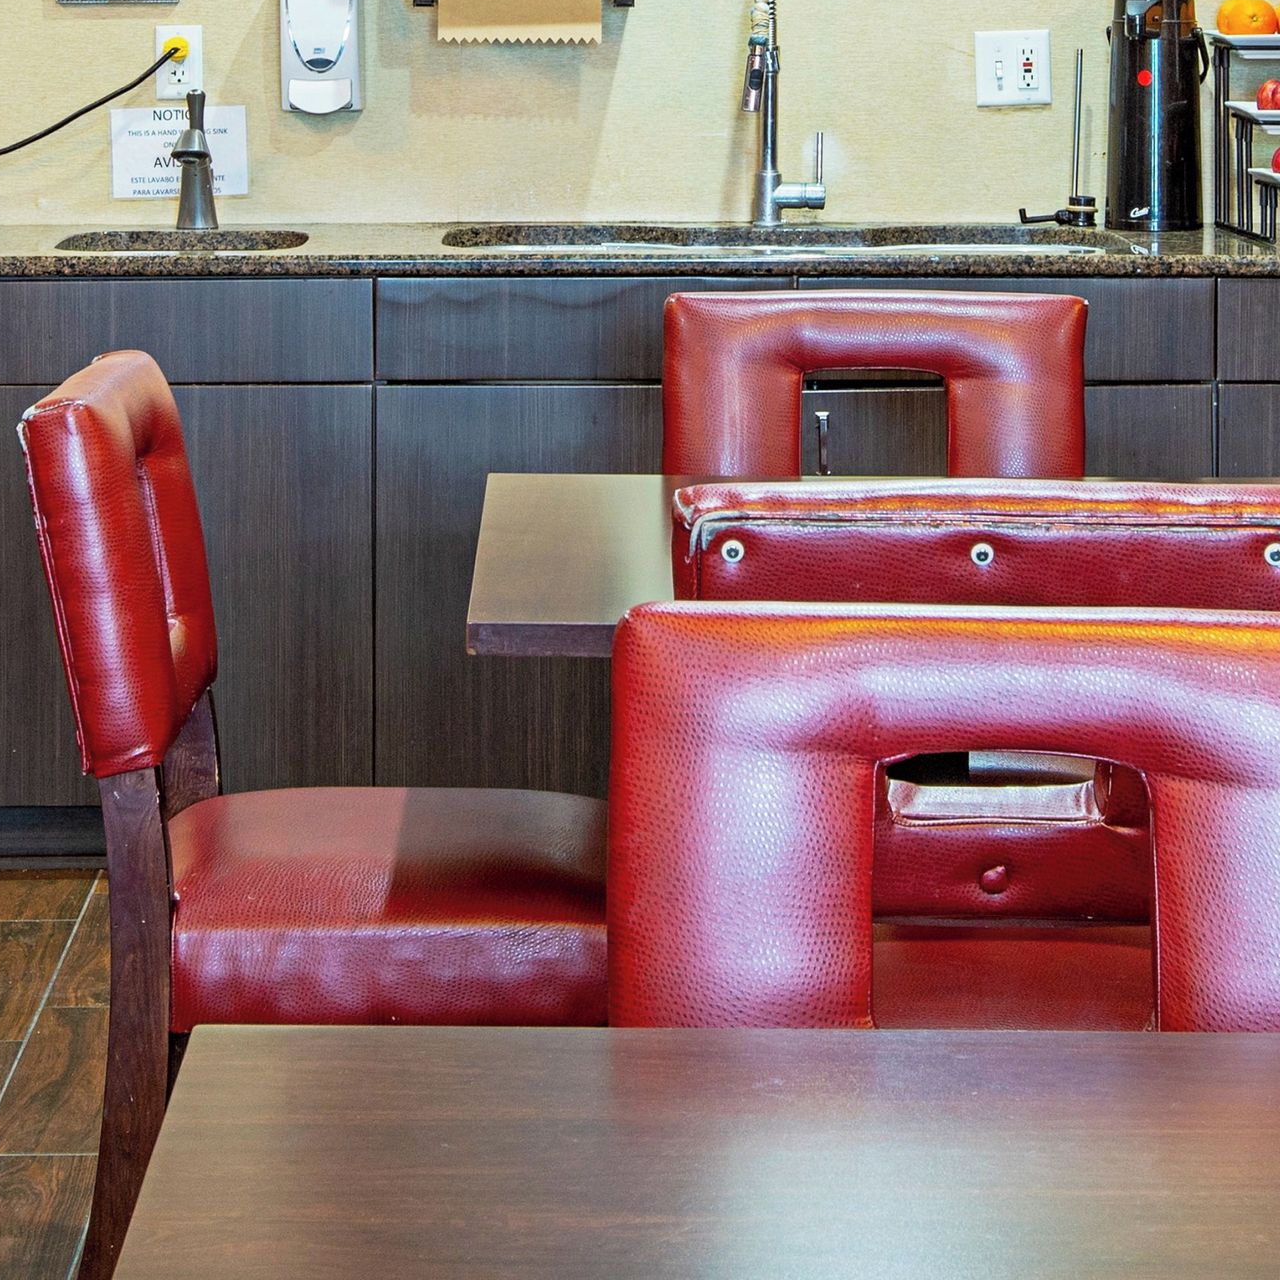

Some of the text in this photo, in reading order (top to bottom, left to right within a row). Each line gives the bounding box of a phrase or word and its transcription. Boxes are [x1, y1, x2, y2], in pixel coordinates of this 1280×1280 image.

[153, 109, 191, 121] NOTIC
[153, 157, 183, 169] AVIS
[132, 188, 151, 196] PARA
